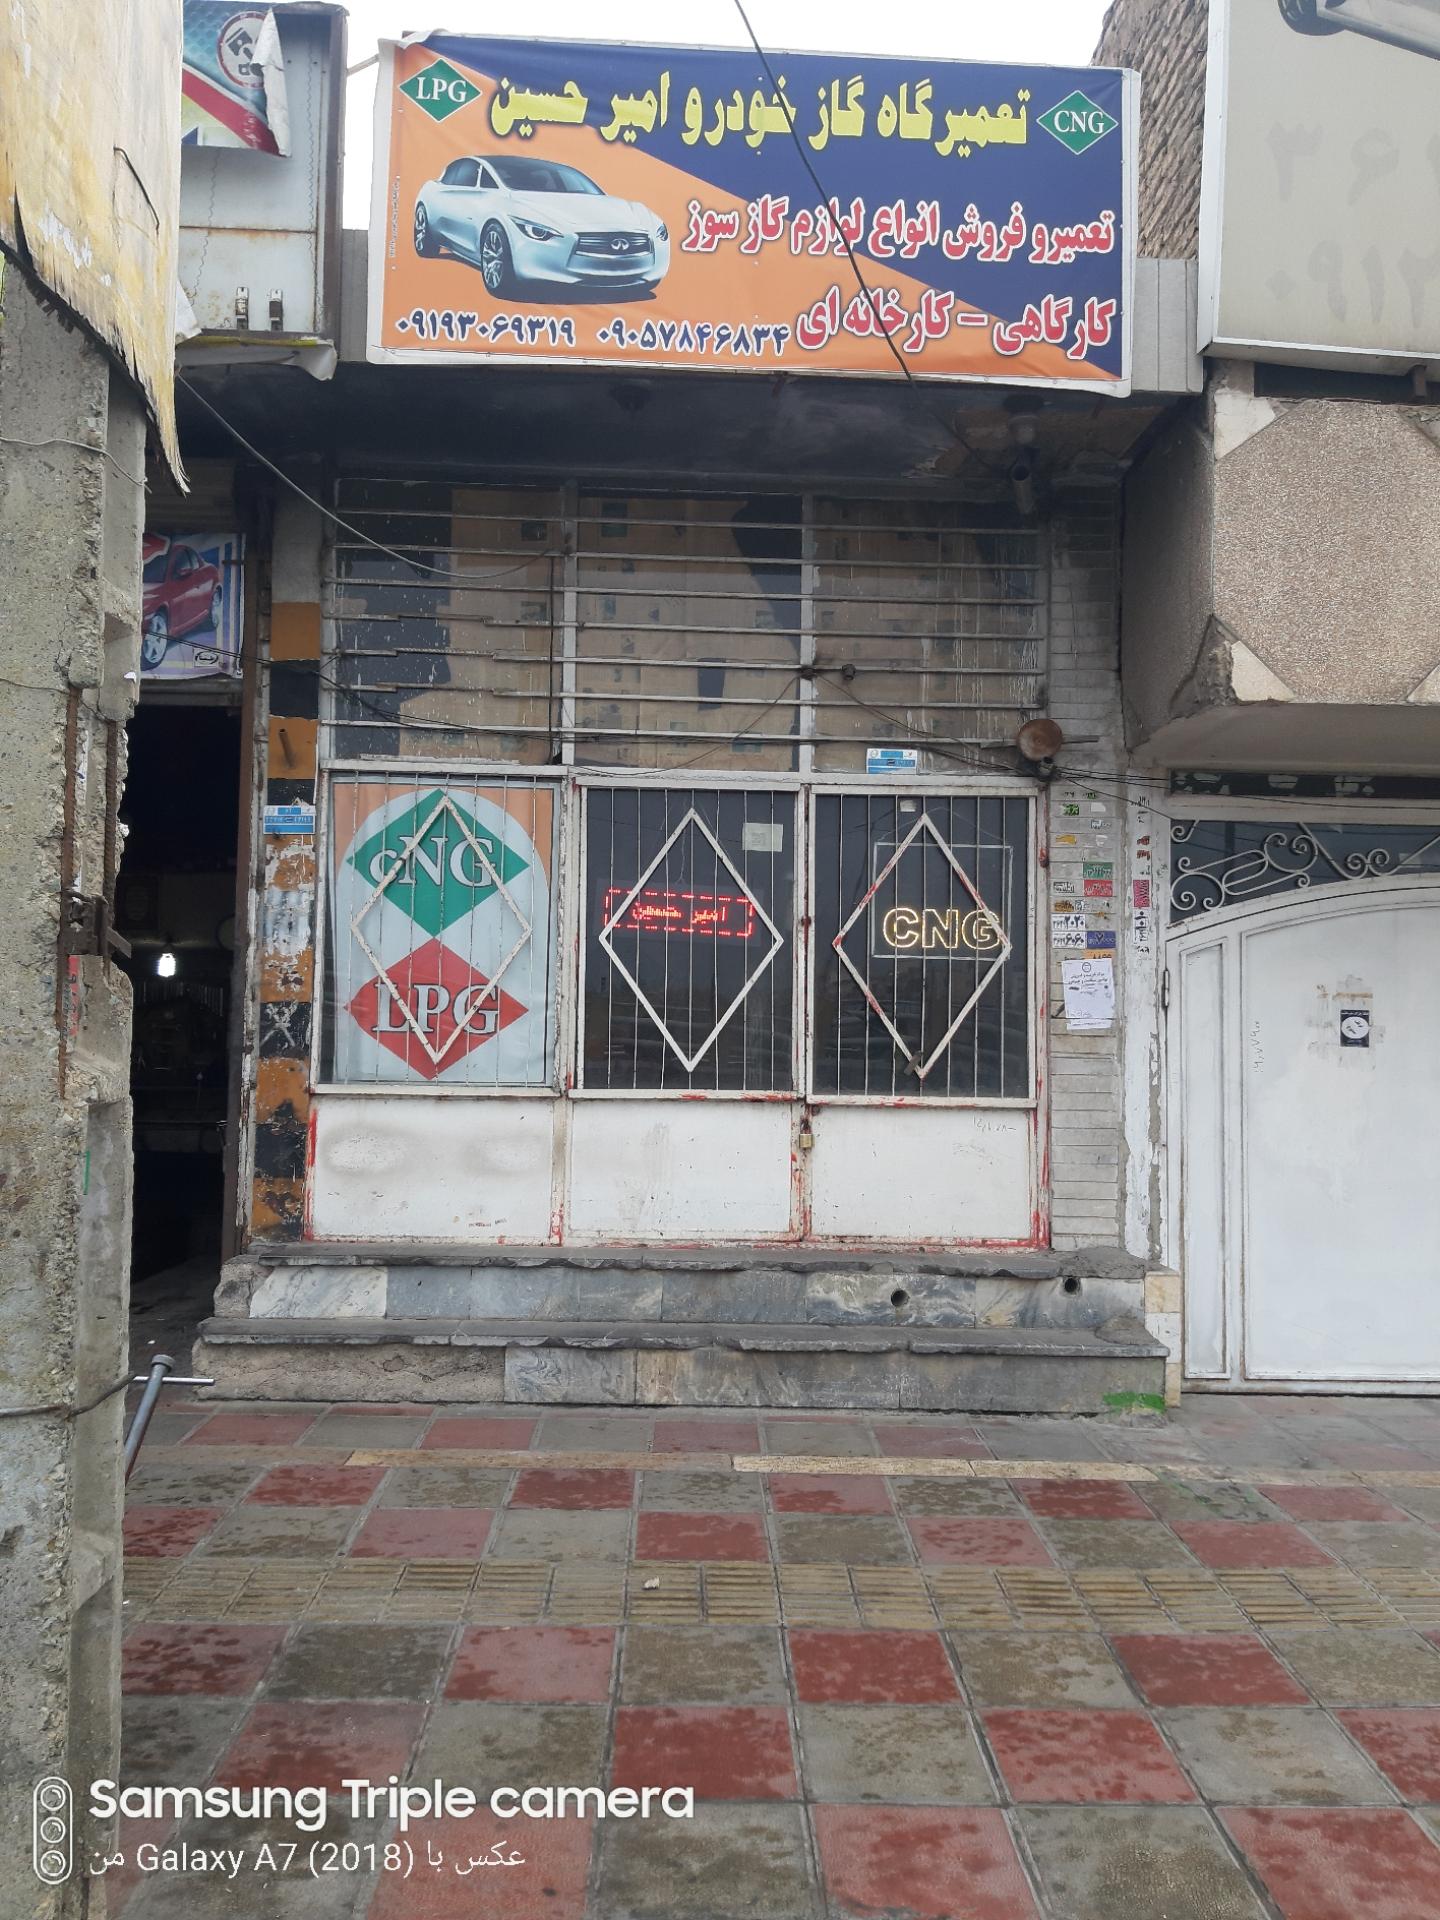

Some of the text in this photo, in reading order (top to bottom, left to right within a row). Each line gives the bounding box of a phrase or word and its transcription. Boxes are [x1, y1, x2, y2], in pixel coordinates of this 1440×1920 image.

[415, 77, 467, 103] LPG
[681, 74, 797, 149] خودرو
[808, 74, 865, 150] گاز
[1053, 110, 1105, 135] CNG
[681, 199, 740, 253] سوز
[741, 194, 789, 254] گاز
[791, 196, 864, 257] لوازم
[868, 199, 940, 260] انواع
[942, 201, 1026, 264] فروش
[396, 309, 576, 346] ۰۹۱۹۳۰۶۹۳۱۹
[596, 317, 790, 357] ۰۹۰۵۷۸۴۶۸۳۴
[993, 293, 1116, 359] کارگاهی
[368, 836, 495, 887] CNG
[883, 908, 1001, 950] CNG
[372, 984, 500, 1034] LPG
